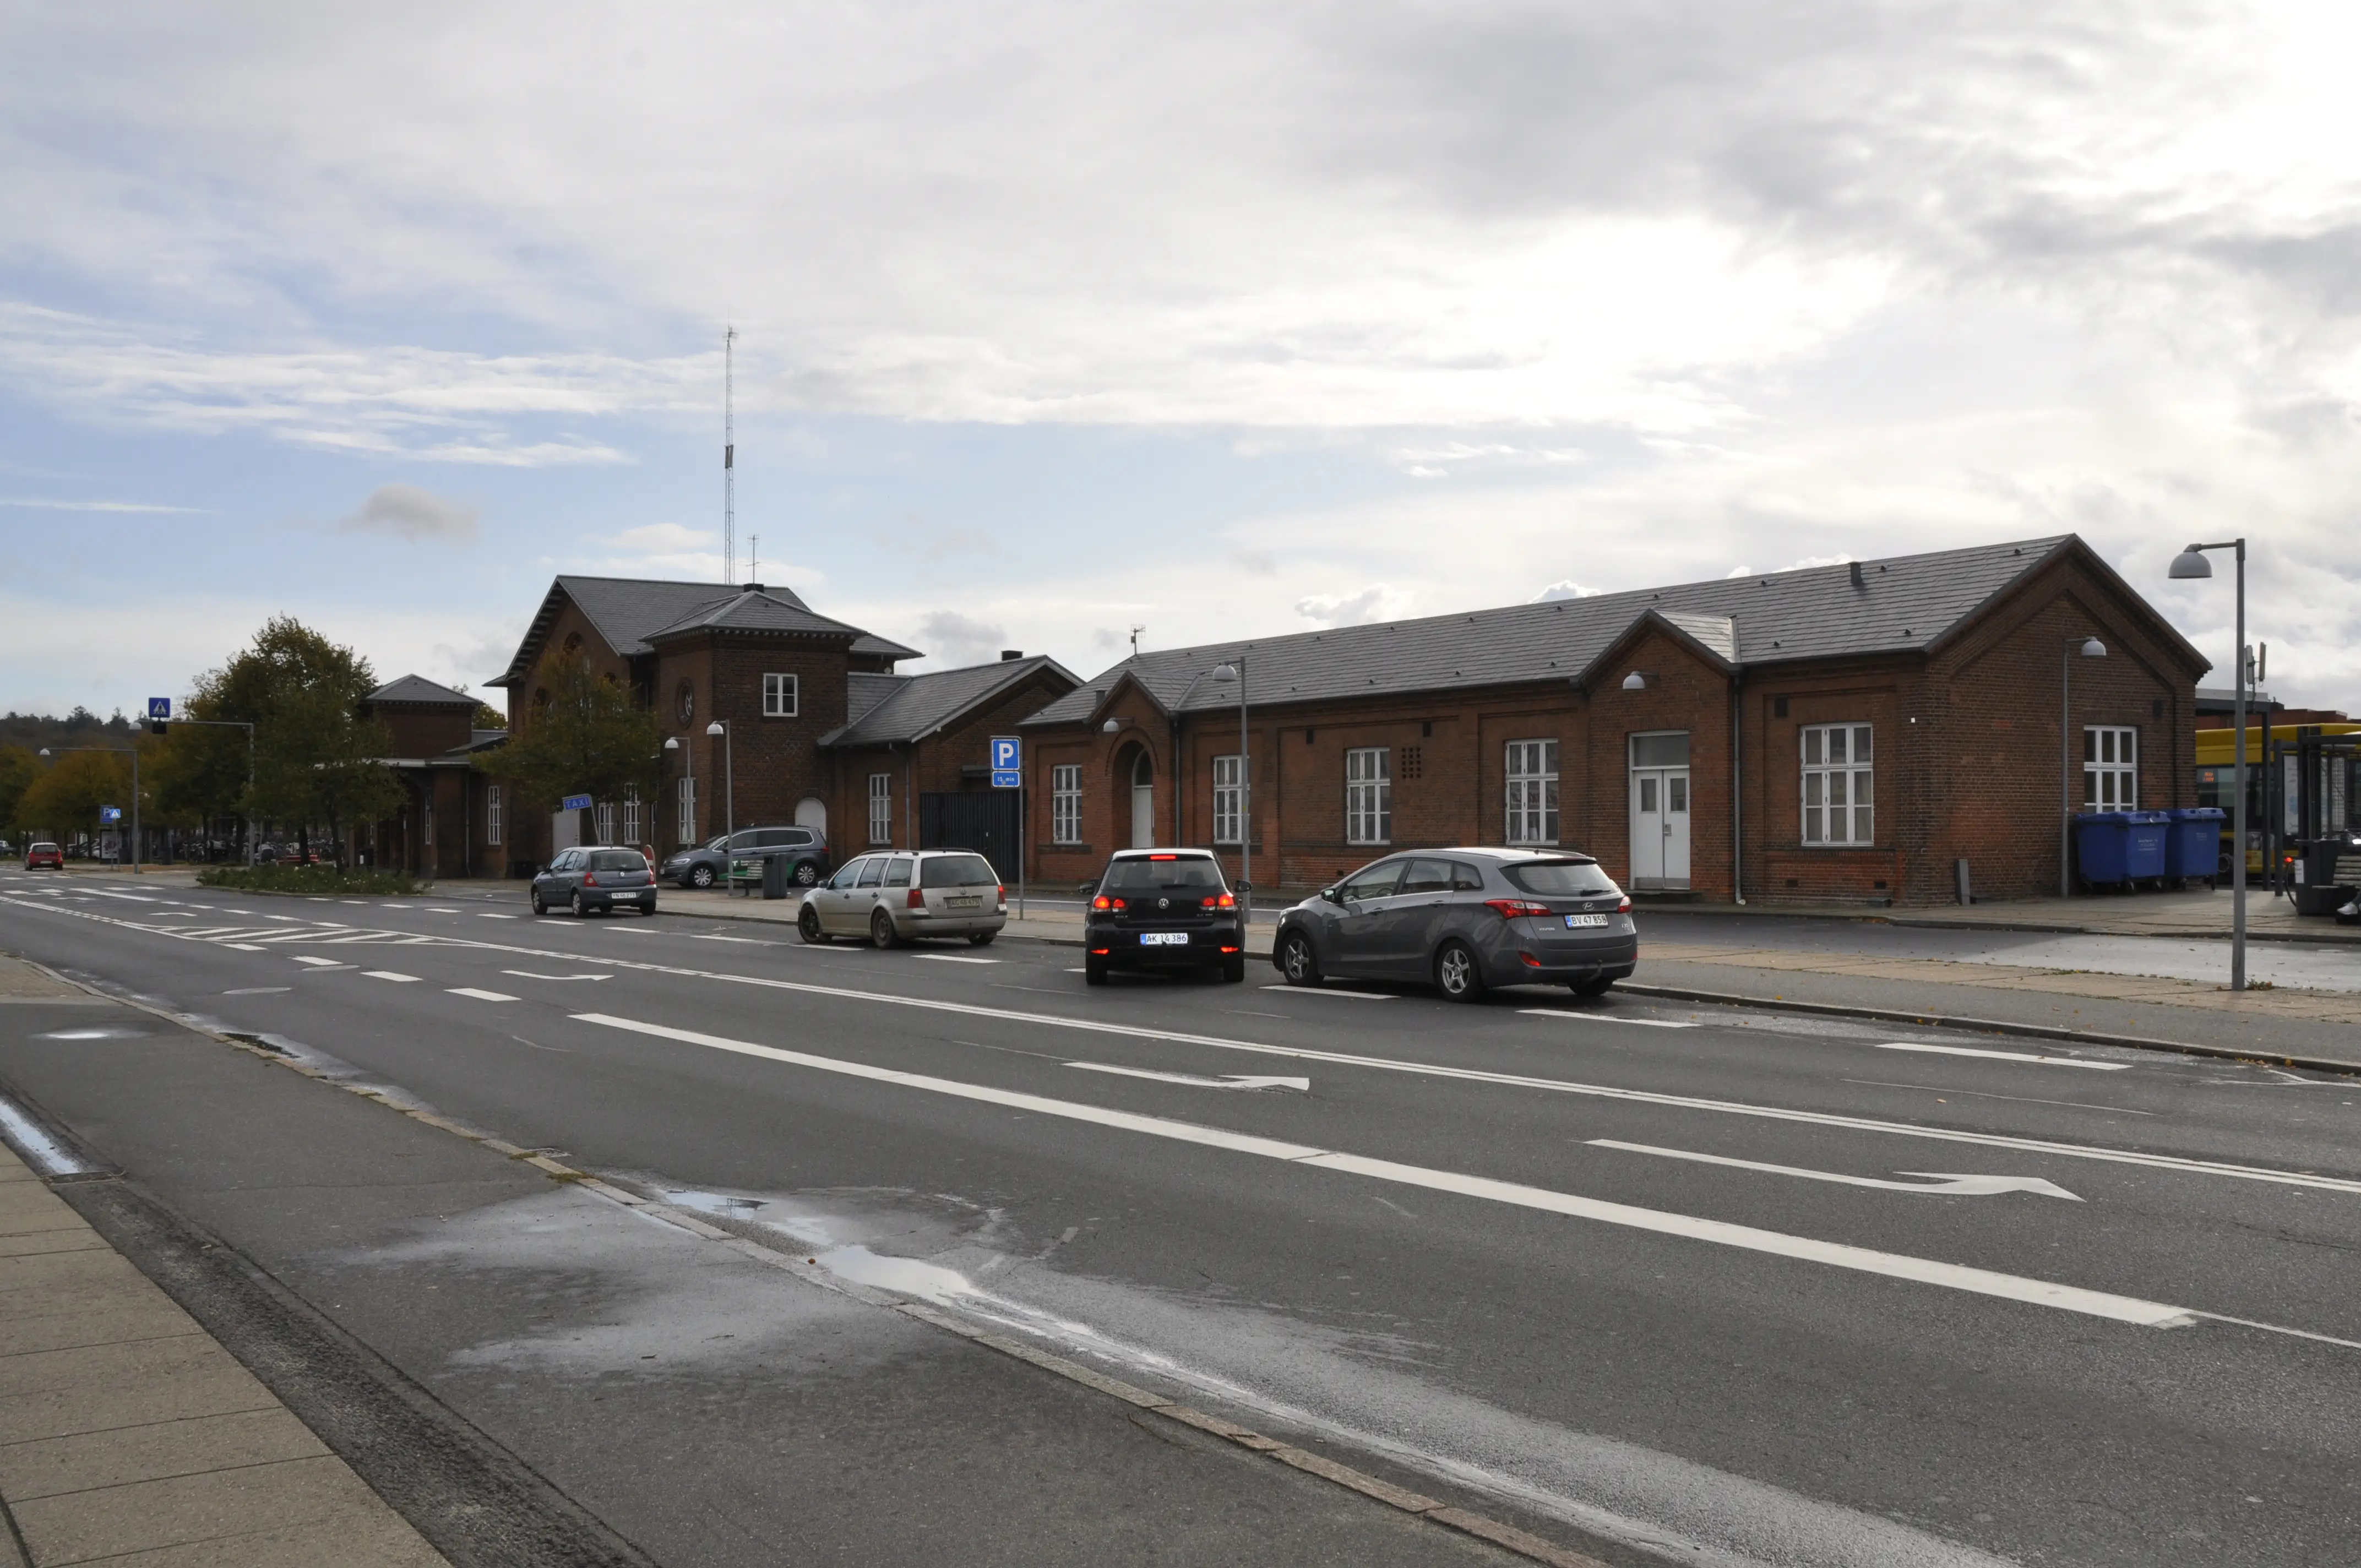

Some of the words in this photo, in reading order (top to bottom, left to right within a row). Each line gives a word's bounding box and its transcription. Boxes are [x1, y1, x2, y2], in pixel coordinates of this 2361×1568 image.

[999, 743, 1014, 766] P
[565, 798, 589, 809] TAXI
[103, 808, 110, 816] P
[1571, 916, 1581, 925] BV
[1584, 916, 1591, 924] 47
[1593, 915, 1607, 924] 858
